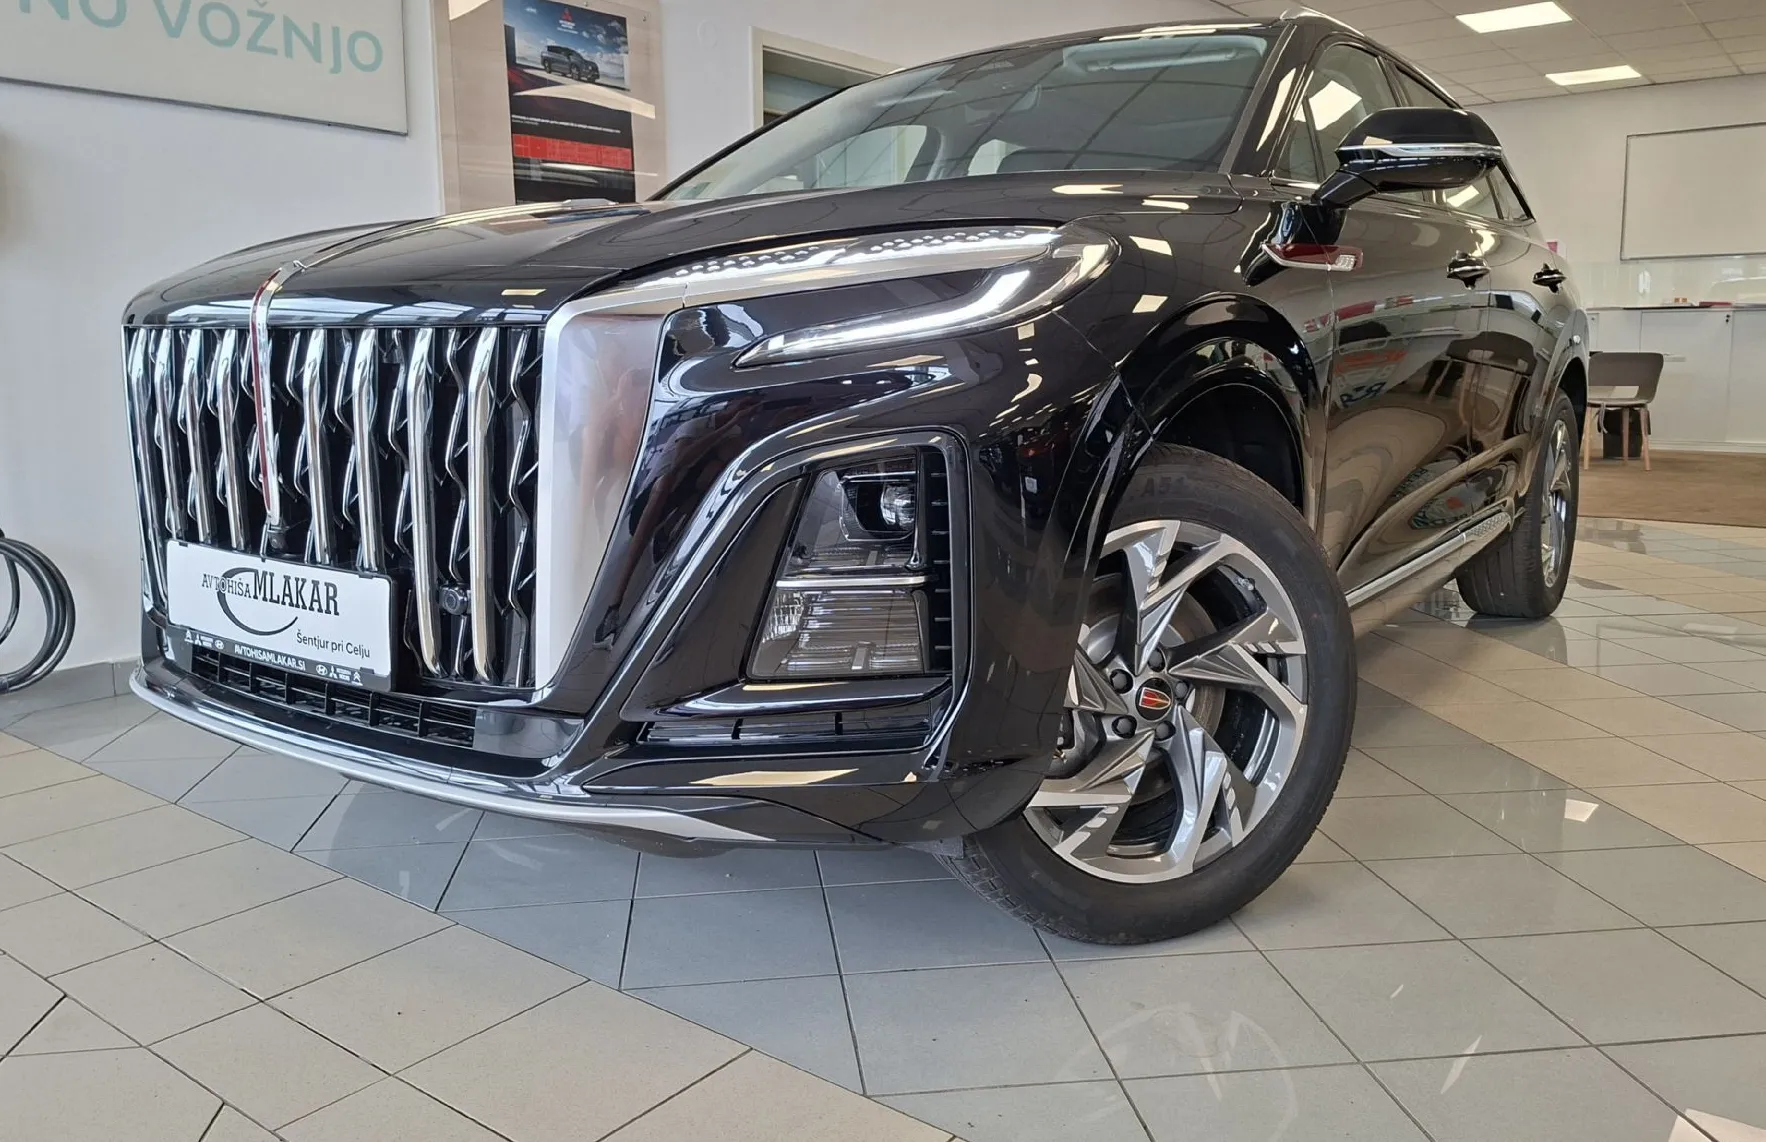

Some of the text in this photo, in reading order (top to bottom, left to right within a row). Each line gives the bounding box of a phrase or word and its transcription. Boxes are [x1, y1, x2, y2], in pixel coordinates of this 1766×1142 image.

[152, 0, 384, 75] VOŽNJO
[252, 569, 340, 616] MLAKAR
[234, 644, 306, 671] AVTOHISAMLAKAR.SI
[296, 628, 371, 659] Šentjur pri Celju
